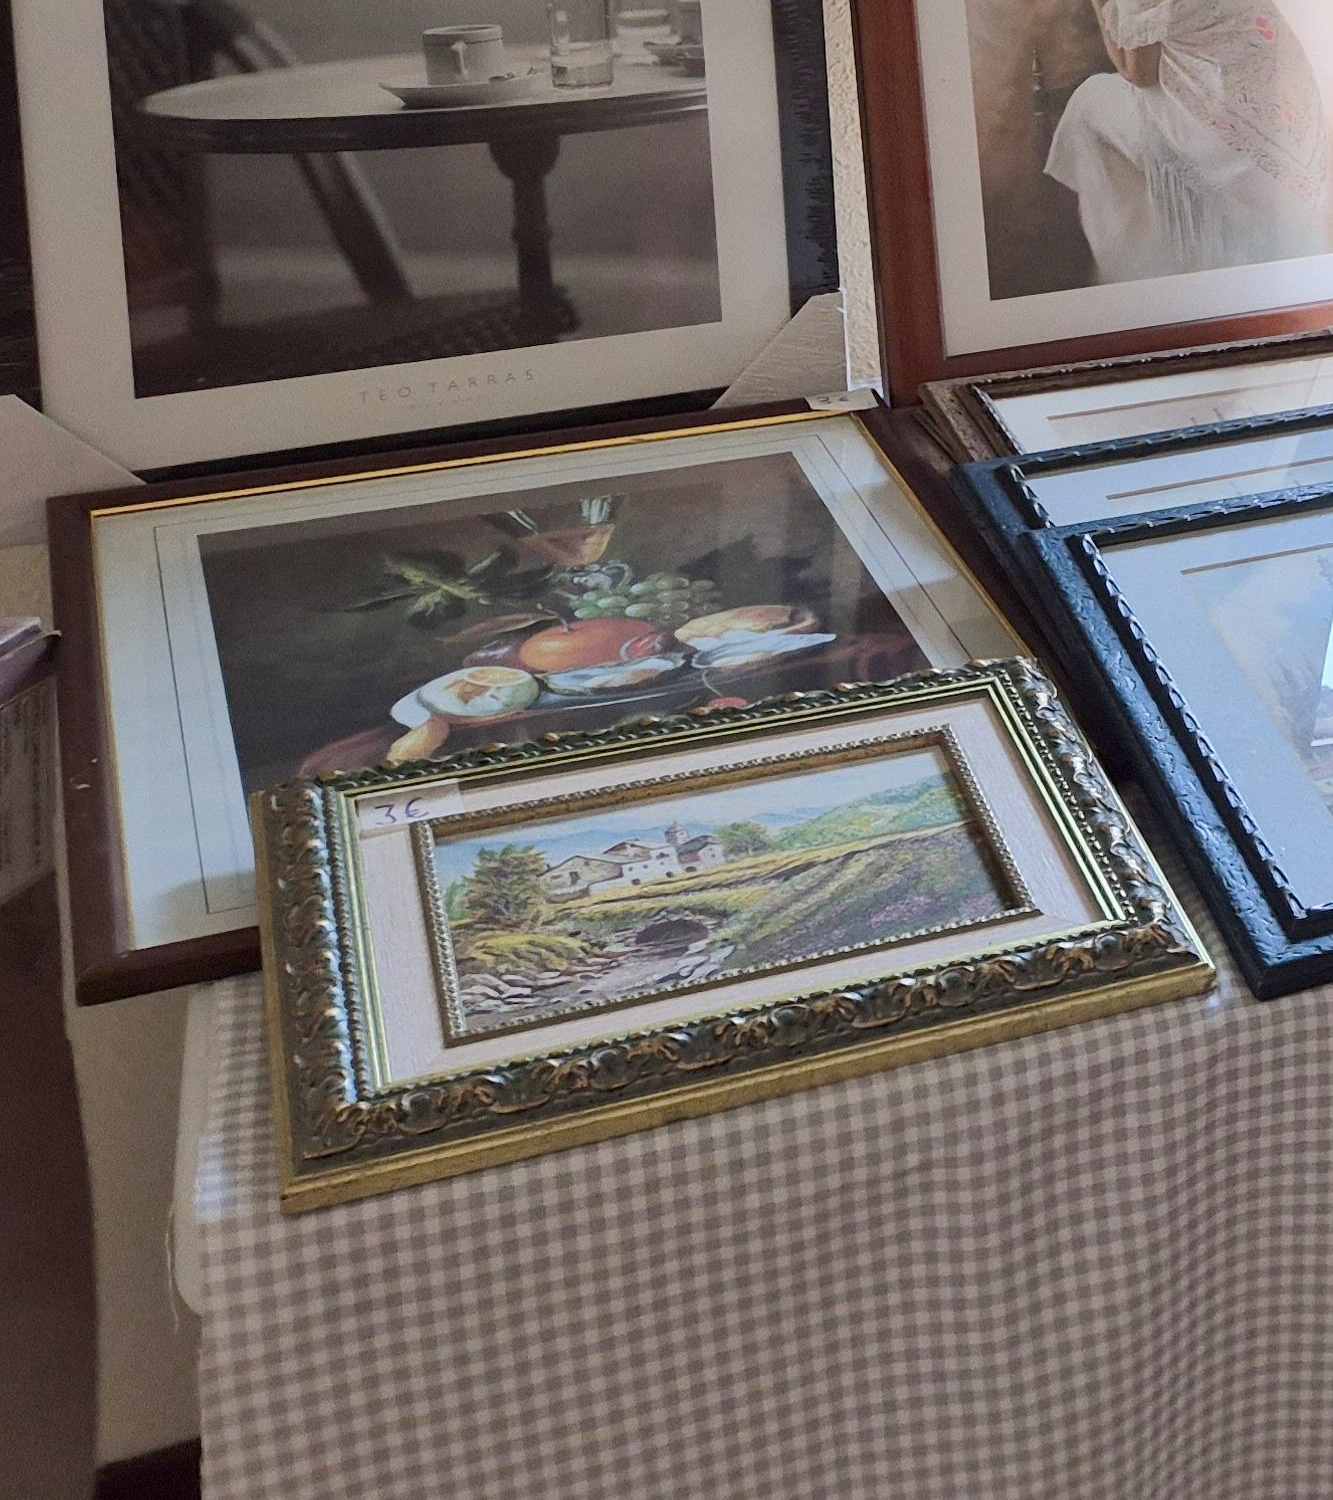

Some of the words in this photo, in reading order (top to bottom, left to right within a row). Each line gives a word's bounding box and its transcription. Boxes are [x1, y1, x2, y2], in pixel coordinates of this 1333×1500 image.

[359, 386, 411, 403] TEO
[428, 369, 535, 394] TARRAS
[373, 797, 430, 826] 3€
